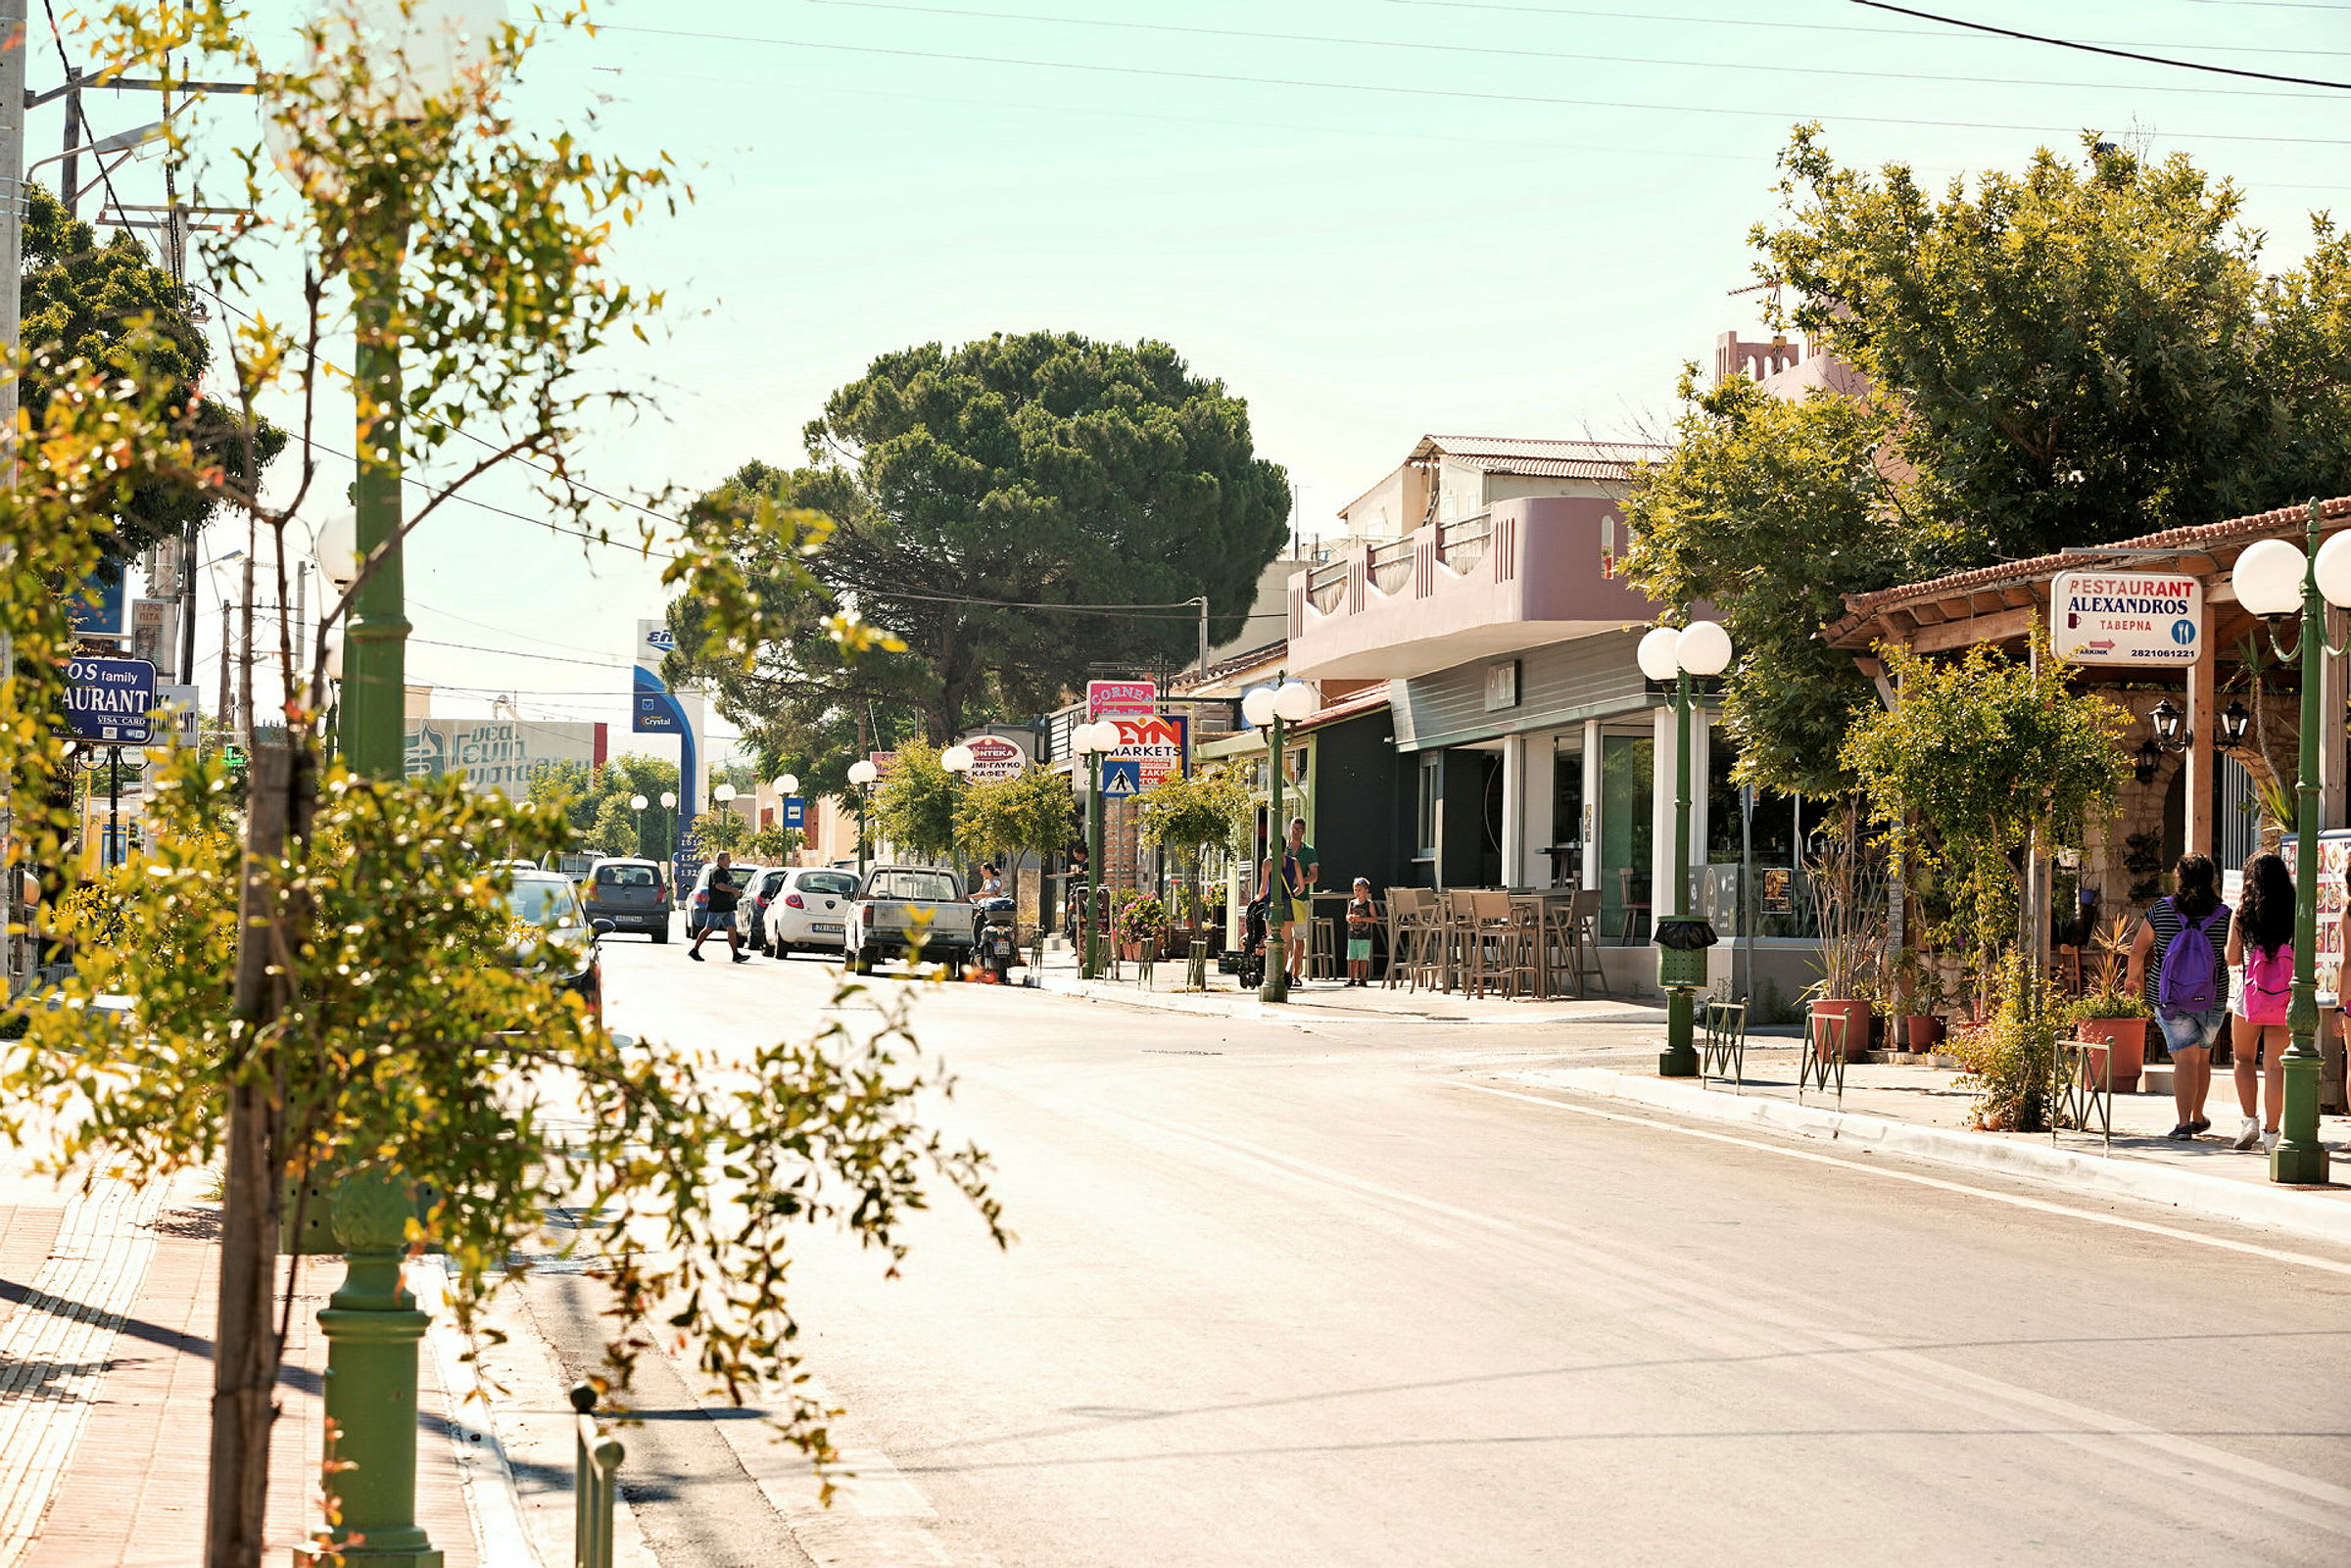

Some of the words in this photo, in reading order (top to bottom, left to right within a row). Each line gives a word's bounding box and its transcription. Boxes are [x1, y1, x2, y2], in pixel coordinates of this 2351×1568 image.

[2069, 580, 2194, 597] RESTAURANT
[2068, 596, 2188, 615] ALEXANDROS
[68, 662, 98, 681] OS
[101, 671, 138, 684] family
[63, 687, 149, 714] AURANT
[1090, 686, 1154, 706] CORNER
[645, 718, 671, 727] Crystal
[1110, 746, 1182, 757] MARKETS
